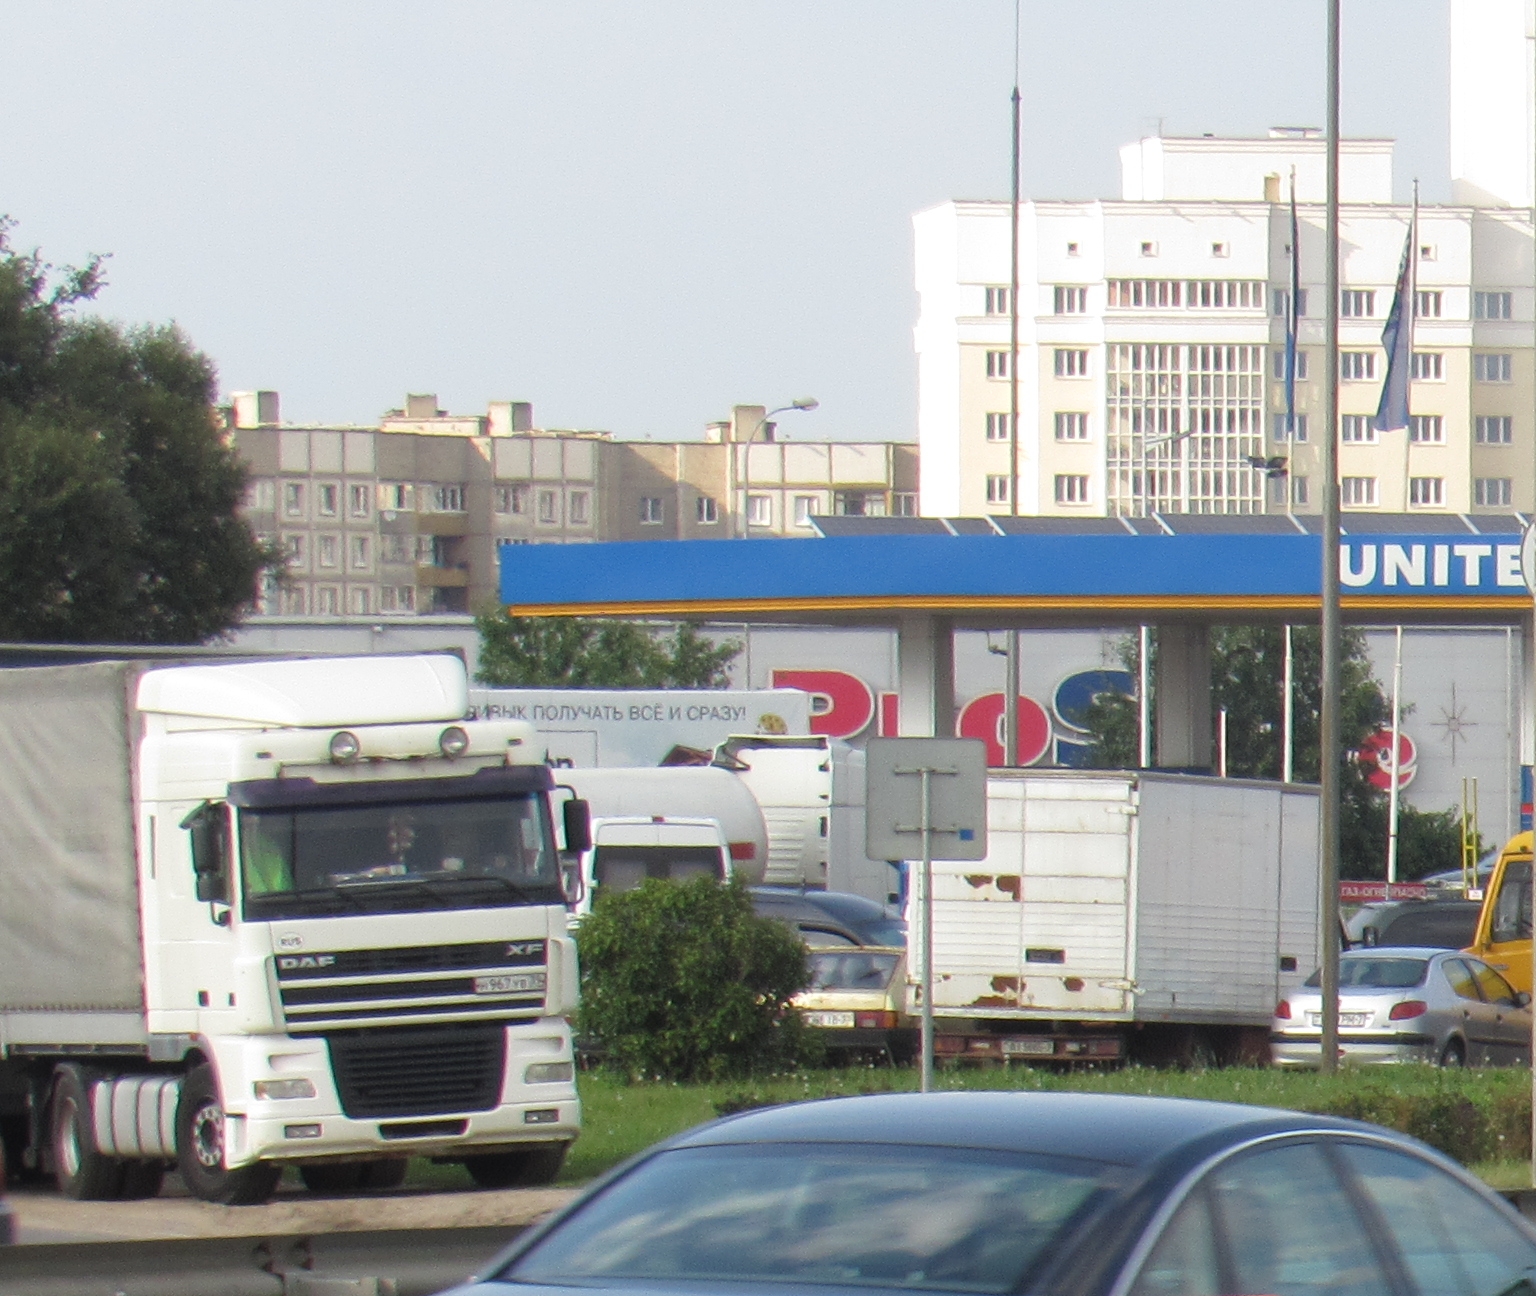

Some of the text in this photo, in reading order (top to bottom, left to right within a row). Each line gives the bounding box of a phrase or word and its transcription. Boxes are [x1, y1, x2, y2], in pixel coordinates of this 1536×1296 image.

[1339, 543, 1523, 588] UNITE
[533, 705, 624, 722] ПОЛУЧАТЬ
[629, 702, 664, 722] ВСЁ
[668, 705, 683, 721] И
[686, 704, 747, 722] СРАЗУ!
[505, 943, 545, 957] XF
[280, 955, 337, 969] DAF
